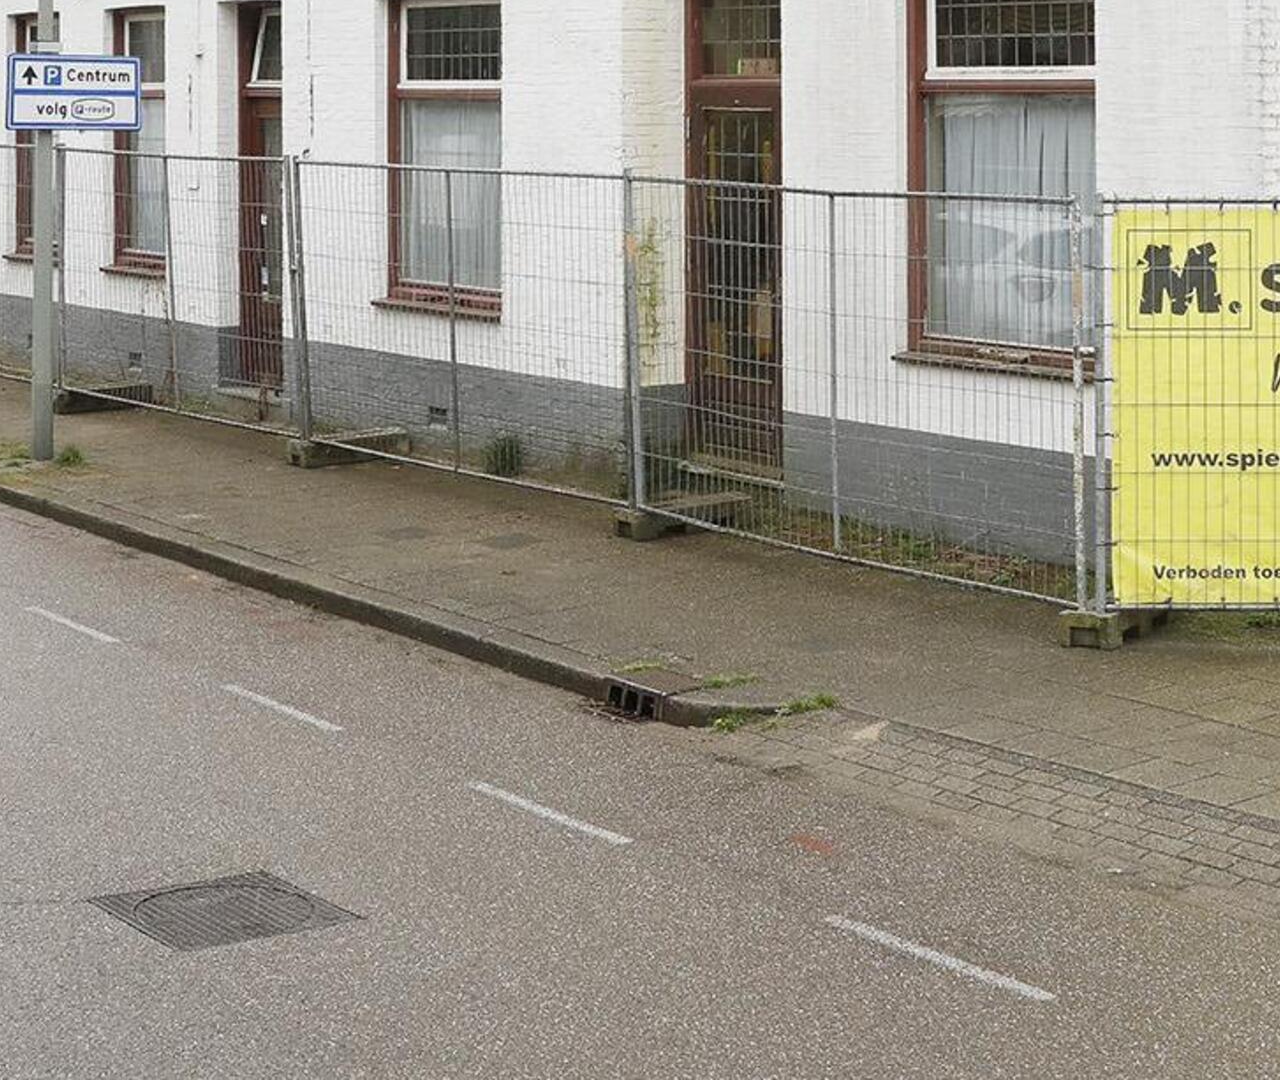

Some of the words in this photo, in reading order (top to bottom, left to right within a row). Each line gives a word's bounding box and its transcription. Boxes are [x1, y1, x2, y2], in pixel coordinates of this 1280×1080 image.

[67, 69, 131, 83] Centrum
[36, 102, 67, 119] volg
[1153, 565, 1246, 580] Verboden
